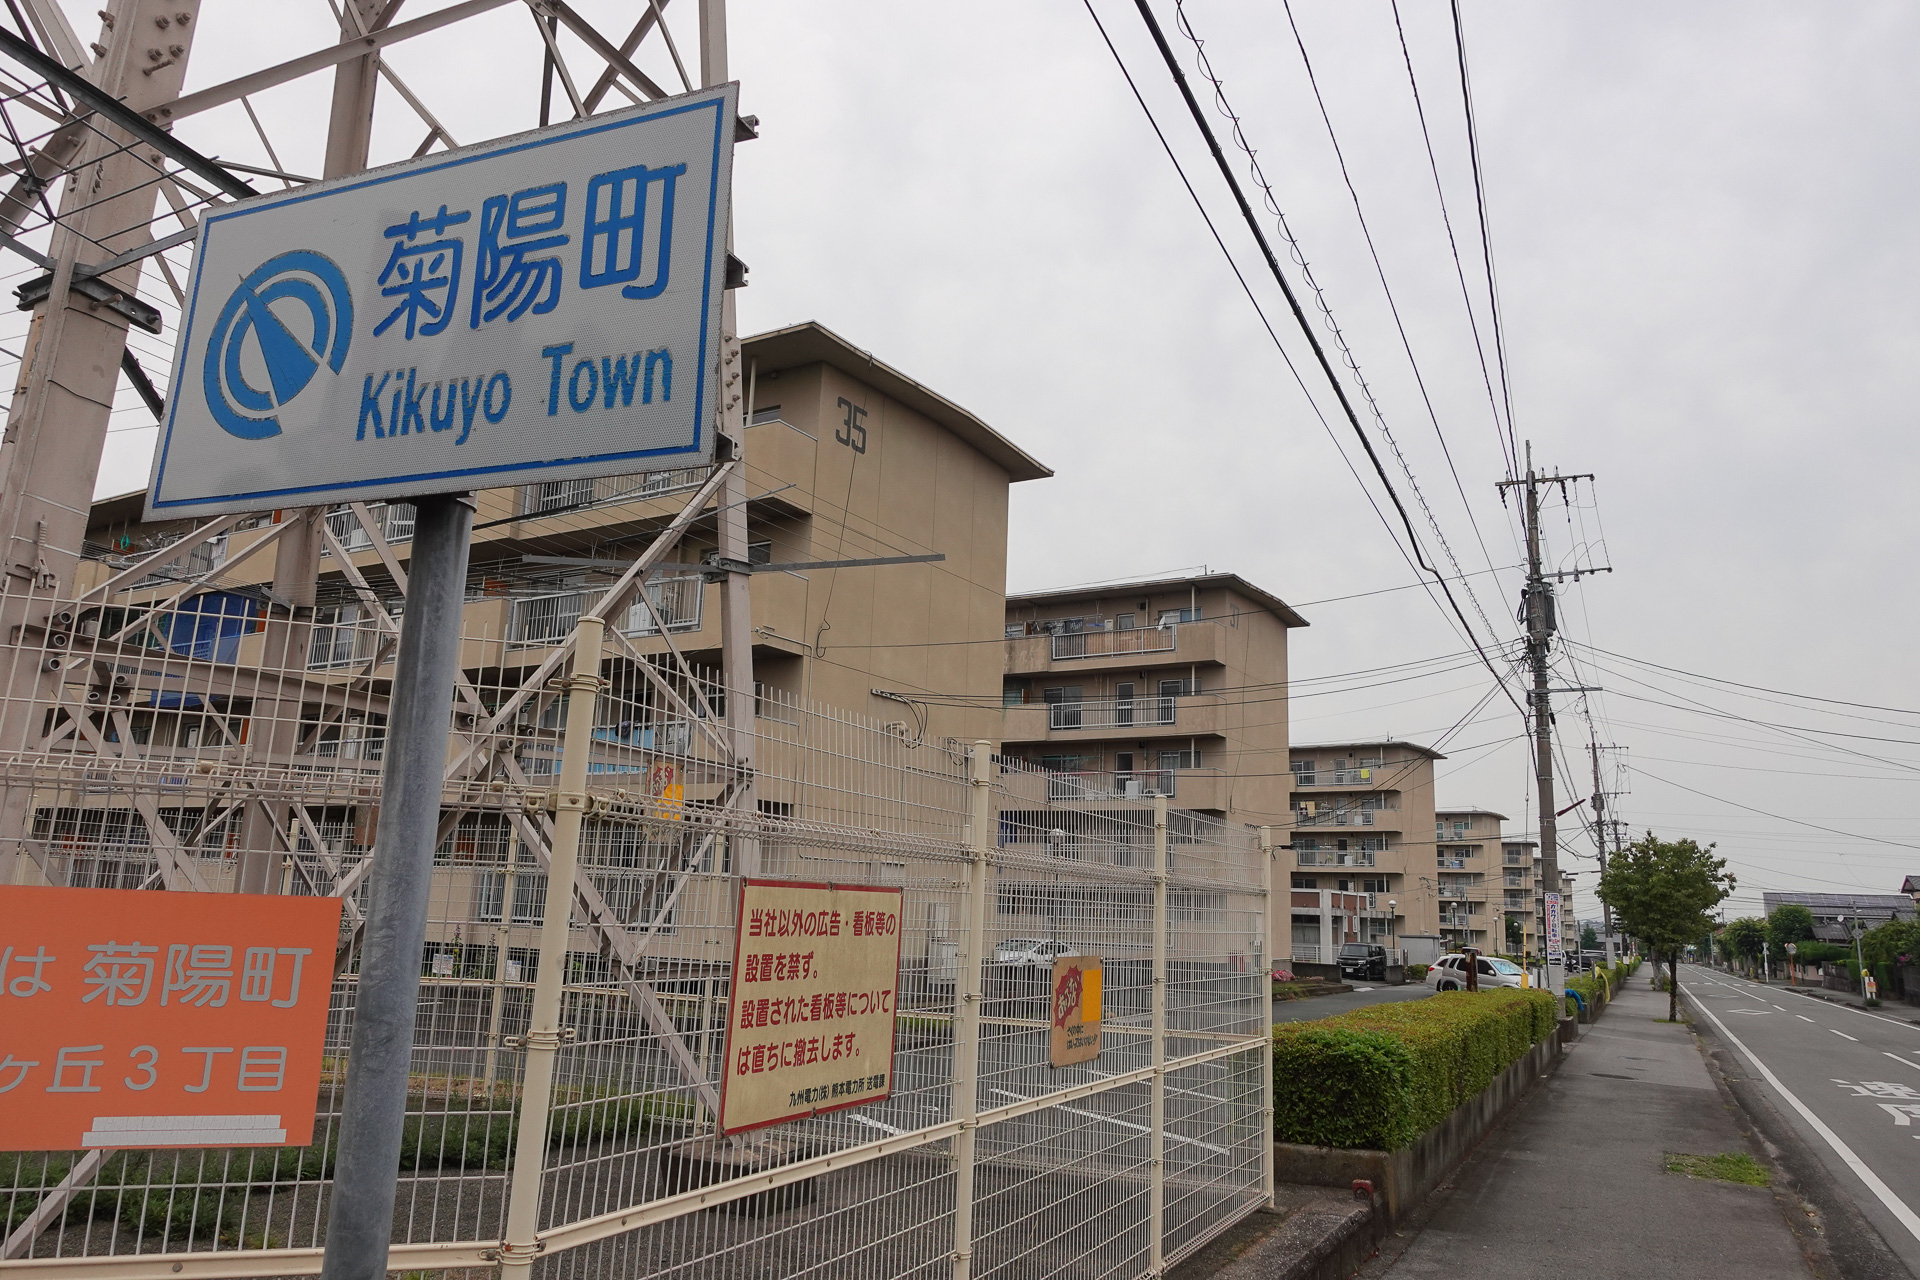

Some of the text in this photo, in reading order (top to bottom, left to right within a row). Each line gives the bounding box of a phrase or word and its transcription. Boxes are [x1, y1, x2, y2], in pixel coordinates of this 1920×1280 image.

[372, 164, 687, 341] 菊陽町
[356, 342, 674, 446] Kikuyo Town
[836, 396, 868, 455] 35
[749, 908, 896, 937] 当社以外の広告・看板等の
[744, 951, 818, 983] 設置を禁ず。
[740, 989, 892, 1030] 設置された看板等について
[736, 1031, 860, 1077] は直ちに撤去します。
